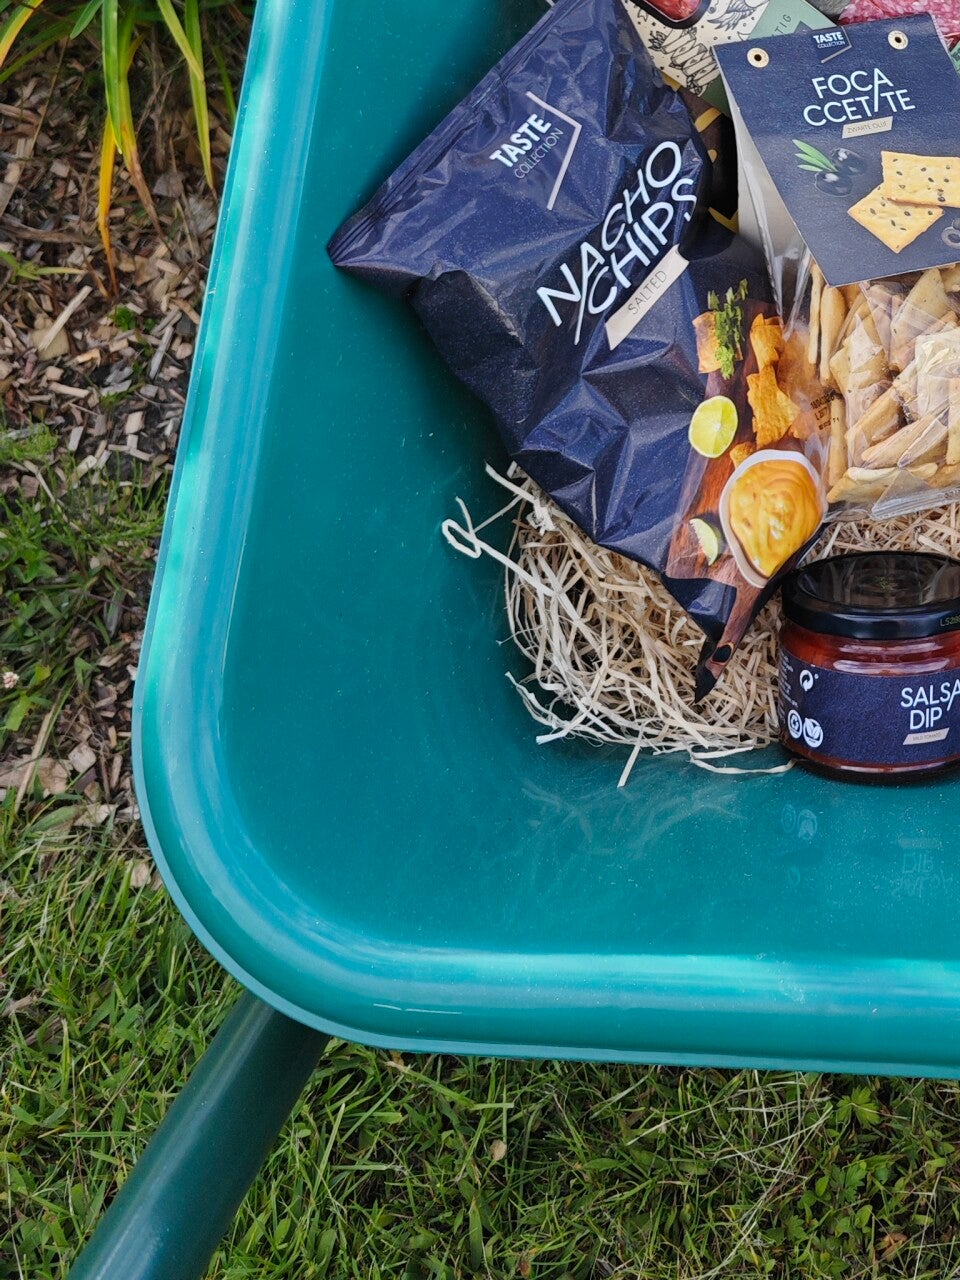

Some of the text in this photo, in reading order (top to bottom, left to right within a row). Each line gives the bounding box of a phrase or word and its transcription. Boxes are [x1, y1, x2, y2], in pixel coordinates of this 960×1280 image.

[813, 31, 843, 43] TASTE
[489, 113, 552, 167] TASTE
[514, 127, 564, 179] COLLECTION
[536, 141, 682, 345] NACHO
[588, 178, 698, 315] CHIPS
[628, 270, 667, 315] SALTED
[909, 707, 943, 731] DIP
